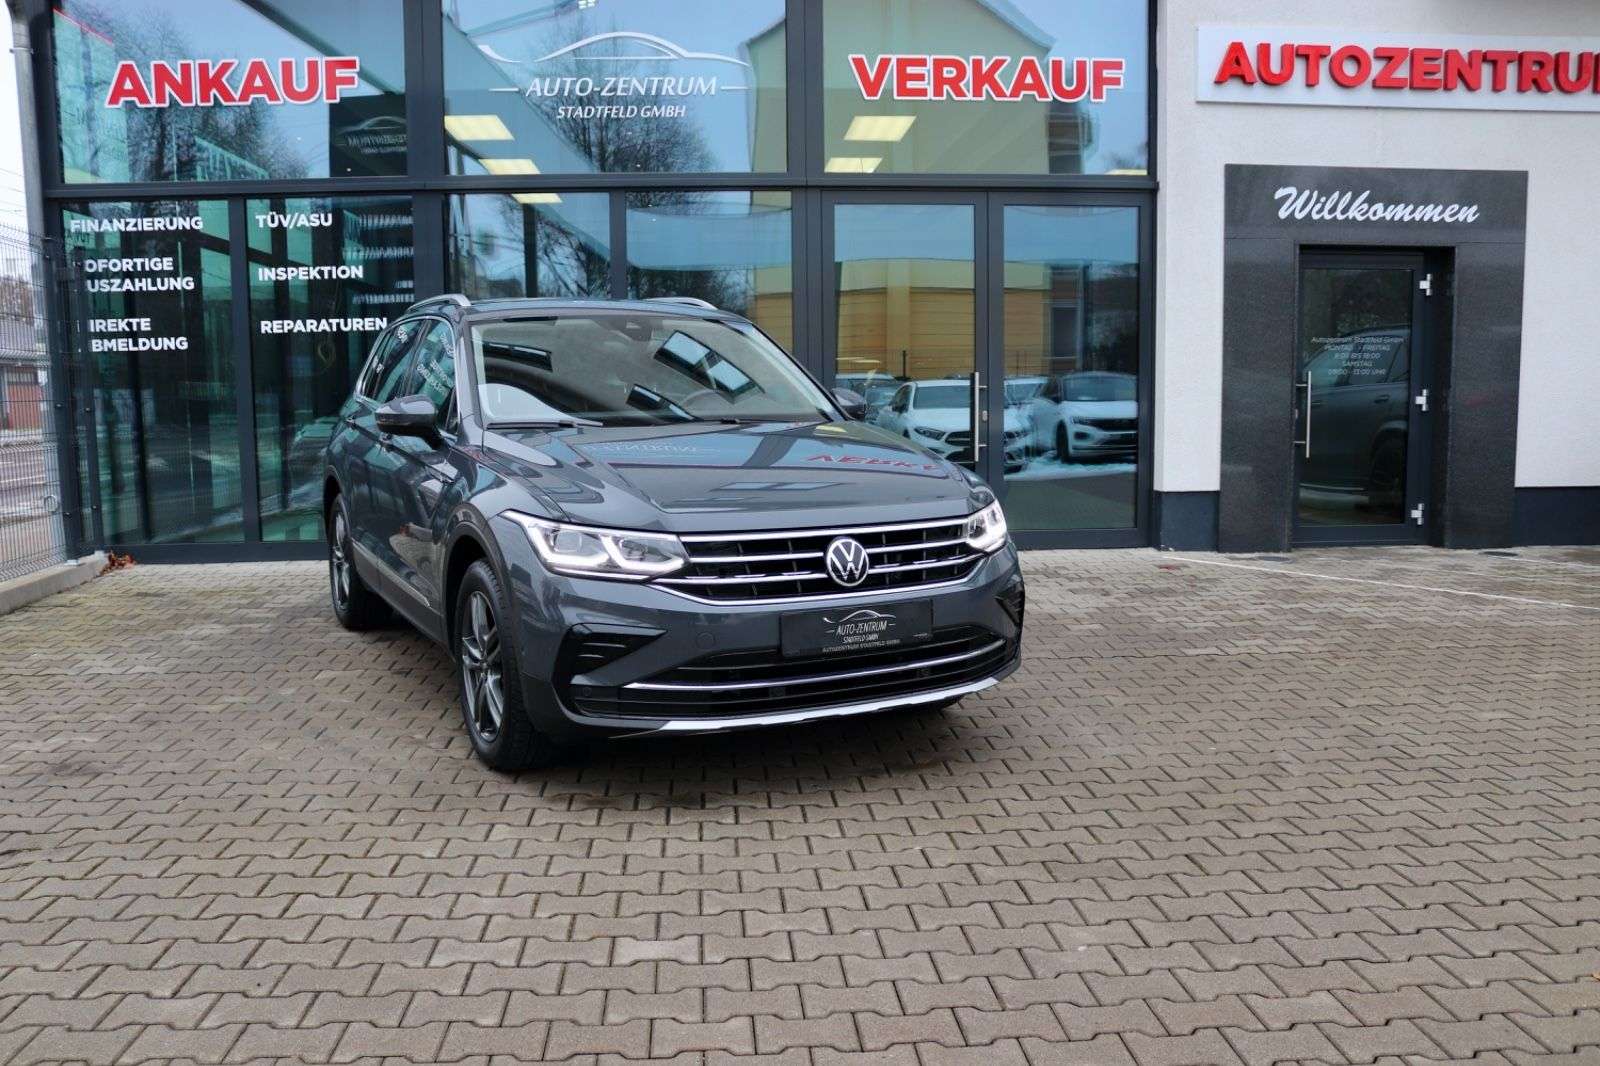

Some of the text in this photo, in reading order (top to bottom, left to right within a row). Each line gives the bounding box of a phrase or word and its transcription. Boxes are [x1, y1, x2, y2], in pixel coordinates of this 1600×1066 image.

[1214, 42, 1600, 95] AUTOZENTRU
[105, 56, 359, 108] ANKAUF
[526, 76, 718, 98] AUTO-ZENTRUM
[848, 54, 1125, 104] VERKAUF
[556, 104, 687, 119] STADTFELD GMBH
[1274, 186, 1480, 224] Willkommen
[70, 216, 204, 233] FINANZIERUNG
[255, 211, 333, 229] TÜV/ASU
[83, 257, 174, 273] OFORTIGE
[258, 265, 364, 281] INSPEKTION
[86, 276, 195, 293] USZAHLUNG
[88, 317, 152, 333] IREKTE
[260, 317, 388, 334] REPARATUREN
[91, 336, 189, 353] BMELDUNG
